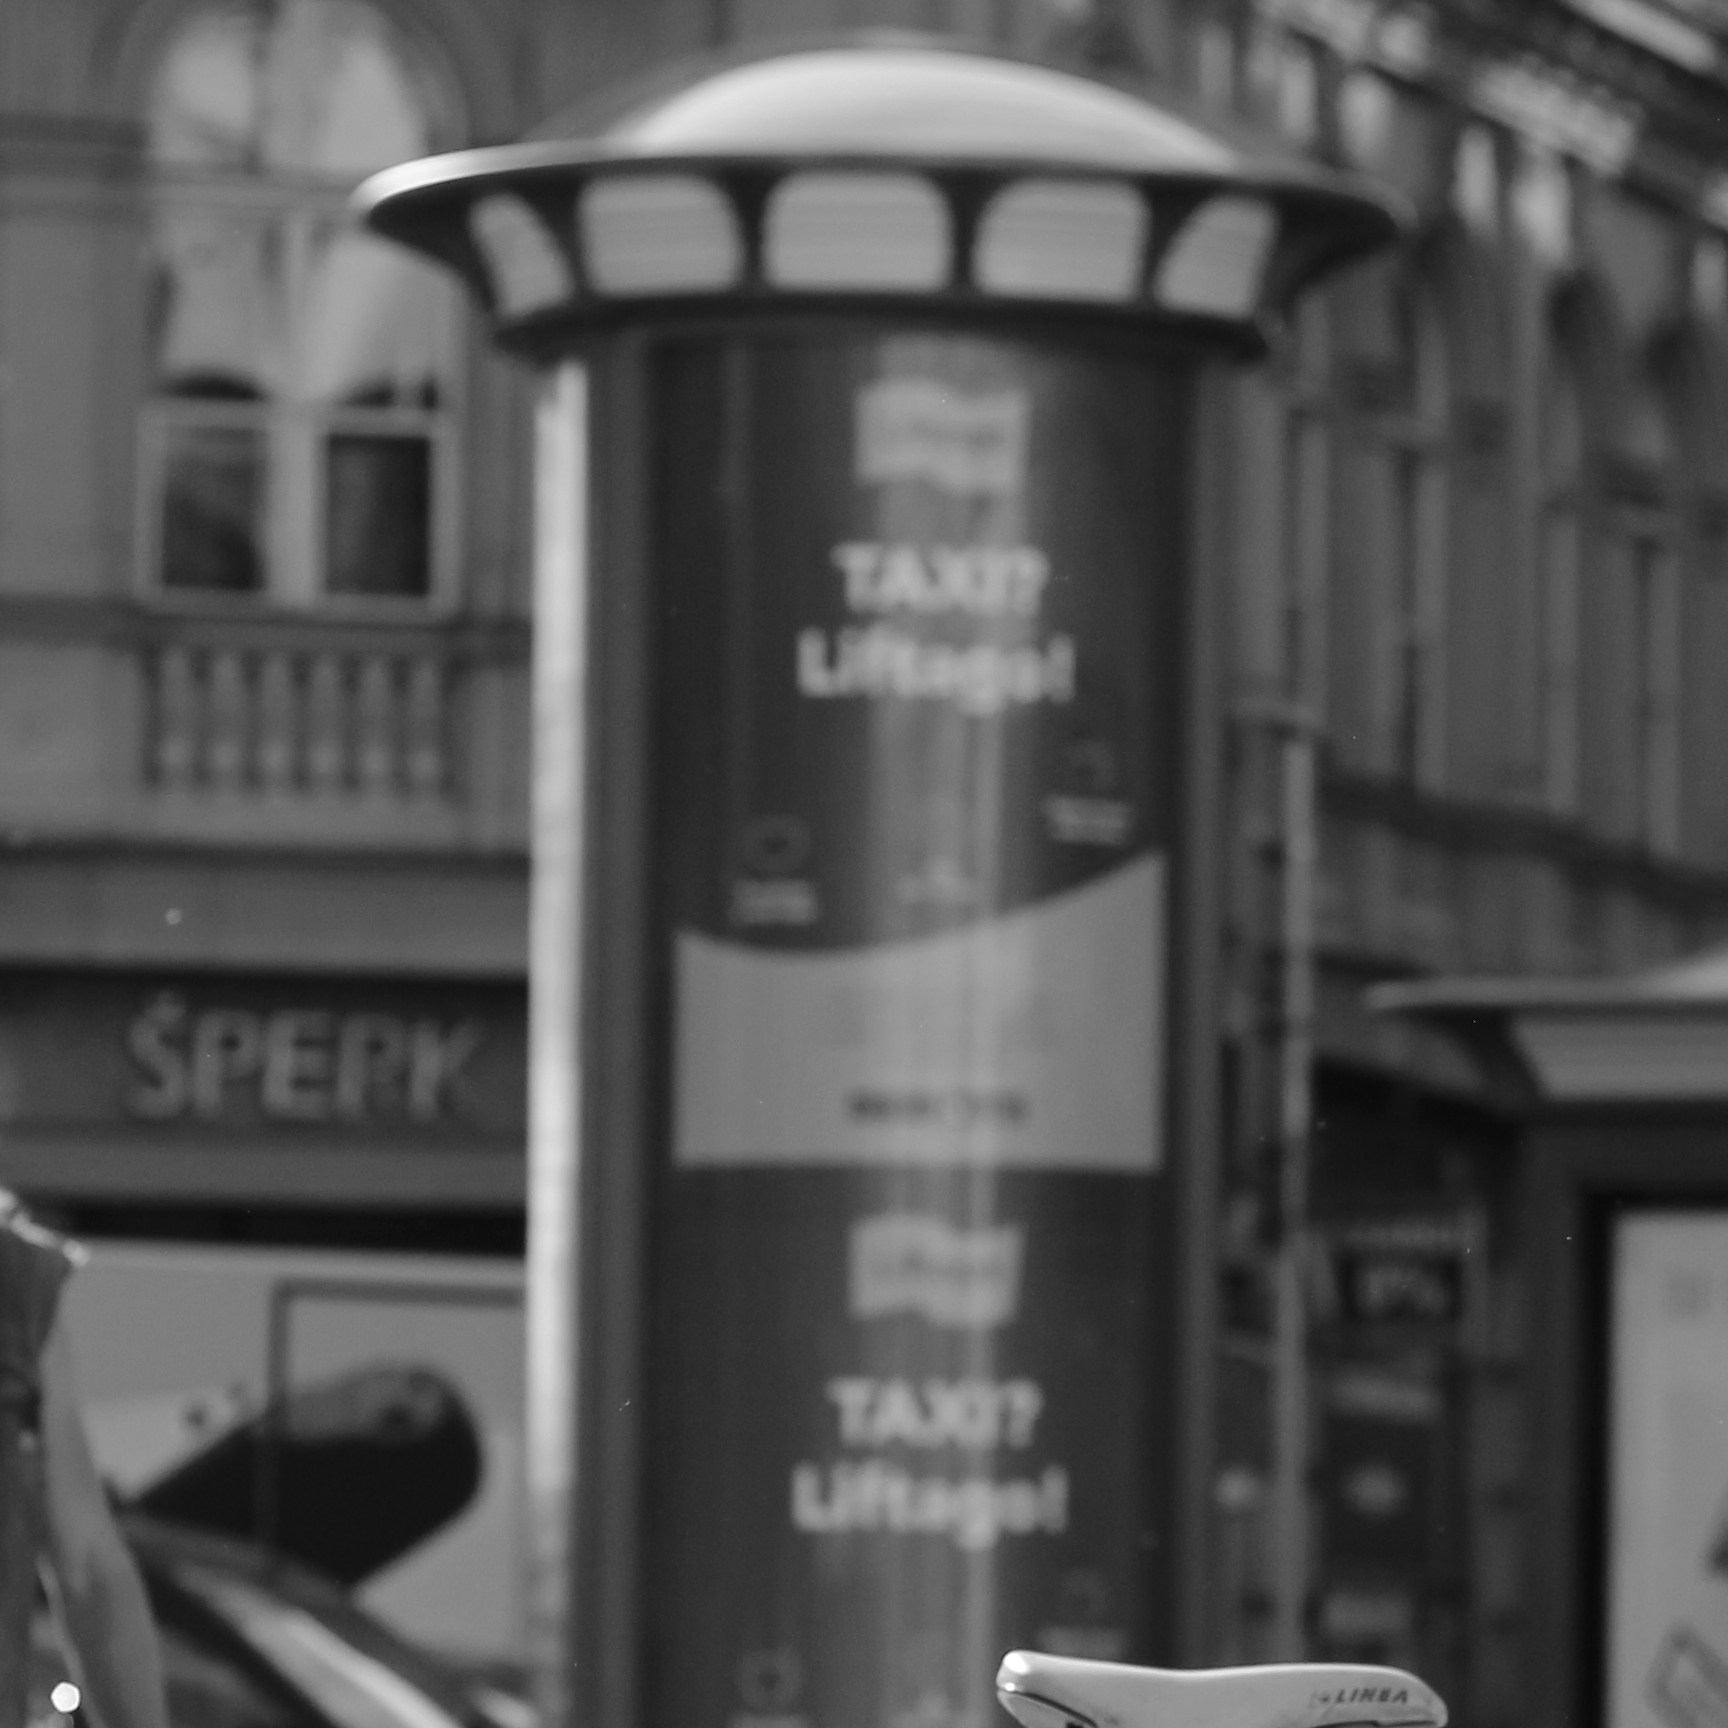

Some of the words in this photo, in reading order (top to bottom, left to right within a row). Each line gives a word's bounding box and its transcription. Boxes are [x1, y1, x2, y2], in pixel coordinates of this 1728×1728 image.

[831, 542, 1048, 614] TAXI?
[797, 624, 1075, 716] Liftago!
[826, 1375, 1041, 1446] TAXI?
[791, 1458, 1068, 1549] Liftago!
[1334, 1688, 1408, 1704] LINEA
